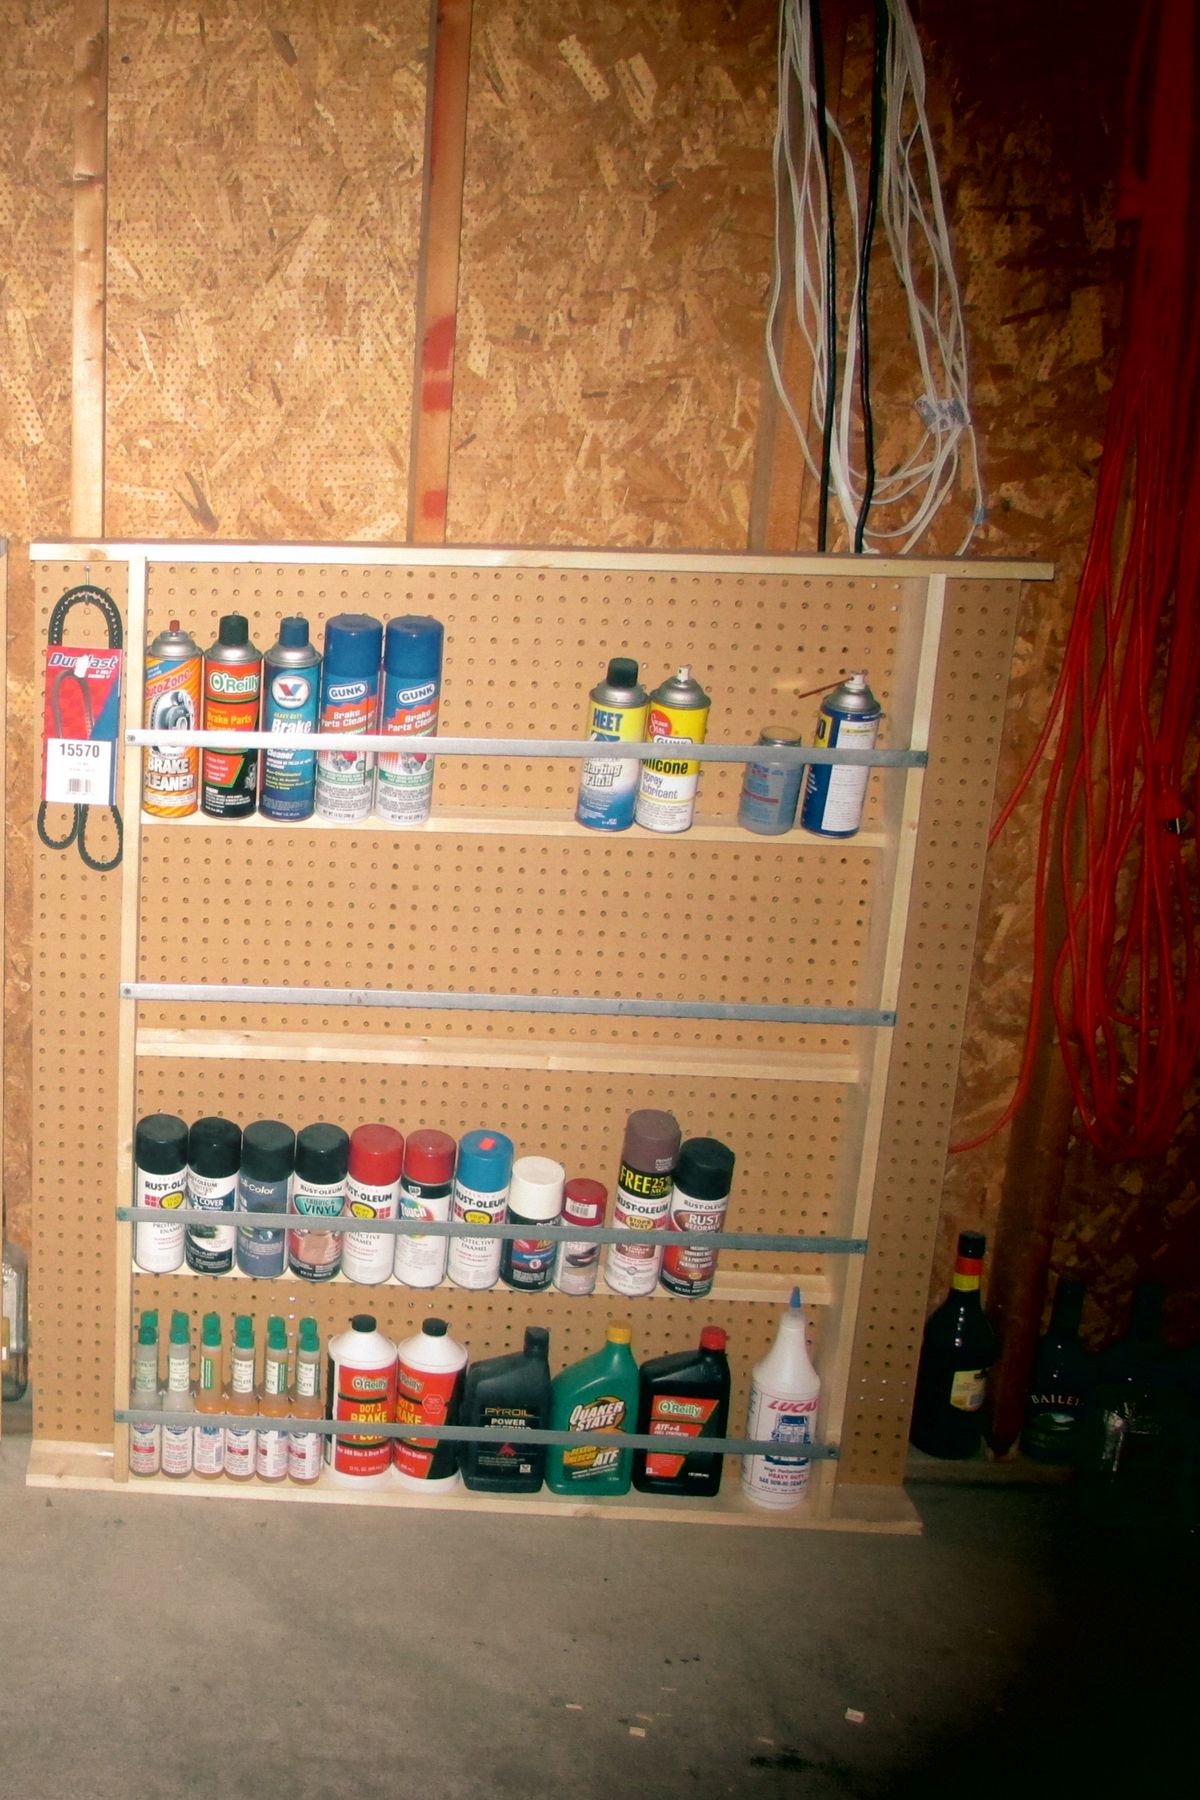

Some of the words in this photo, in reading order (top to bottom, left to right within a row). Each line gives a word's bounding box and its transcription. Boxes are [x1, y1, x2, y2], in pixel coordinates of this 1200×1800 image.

[49, 652, 119, 669] Durlast
[210, 672, 260, 693] O'Reilly
[330, 685, 364, 699] GUNK
[402, 684, 435, 702] GUNK
[207, 711, 229, 724] Brake
[230, 714, 252, 725] Parts
[333, 709, 361, 720] Brake
[405, 709, 432, 722] Brake
[593, 707, 624, 732] HEET
[271, 718, 312, 734] Brake
[387, 721, 412, 731] Parts
[59, 743, 100, 757] 15570
[148, 757, 189, 775] BRAKE
[586, 774, 615, 787] Fluid
[144, 1177, 186, 1191] RUST-OLE
[619, 1165, 651, 1194] FREE
[300, 1184, 343, 1195] RUST-OLEUM
[346, 1184, 393, 1203] UST-OLEUM
[199, 1198, 224, 1207] COVER
[455, 1189, 507, 1209] RUST-OLEUM
[616, 1194, 669, 1215] RUST-OLEUM
[303, 1204, 337, 1215] VINYL
[688, 1213, 720, 1226] RUST
[353, 1377, 388, 1391] O'Reilly
[400, 1373, 423, 1393] Reilly
[359, 1404, 375, 1413] DOT
[484, 1407, 534, 1417] PYROIL
[658, 1400, 702, 1417] O'Reilly
[767, 1398, 820, 1413] LUCAS
[350, 1412, 388, 1424] BRAKE
[398, 1408, 422, 1425] AKE
[569, 1401, 625, 1426] QUAKER
[491, 1417, 526, 1426] POWER
[575, 1413, 617, 1432] STATE
[654, 1423, 681, 1433] ATF+4
[592, 1451, 620, 1467] ATF
